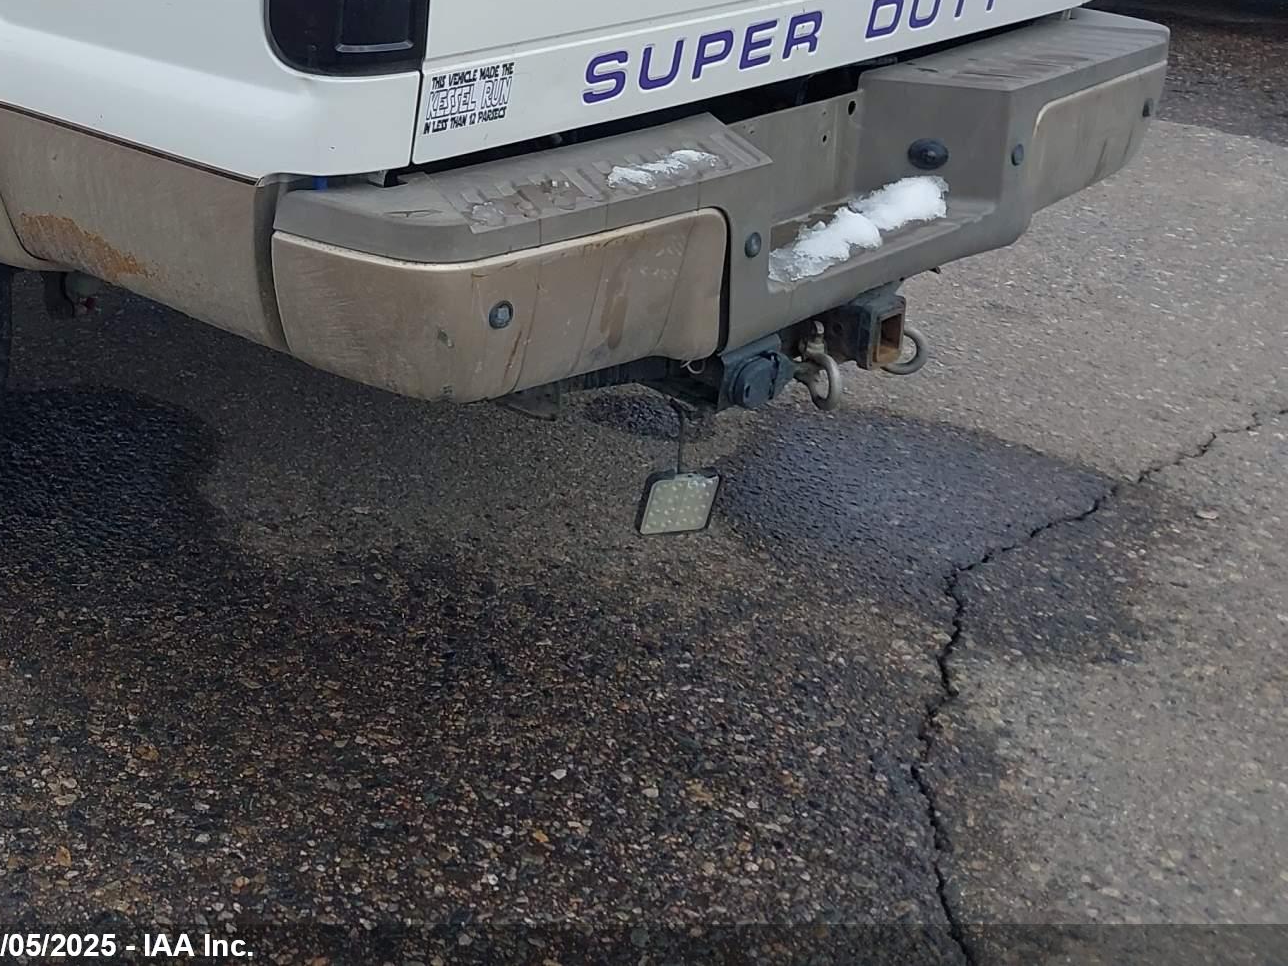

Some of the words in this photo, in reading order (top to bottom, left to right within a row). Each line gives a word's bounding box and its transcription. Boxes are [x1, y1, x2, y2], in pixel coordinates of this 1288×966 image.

[432, 75, 446, 88] THIS
[449, 69, 477, 86] VEHICLE
[479, 65, 500, 80] MADE
[502, 62, 514, 75] THE
[582, 10, 824, 105] SUPER
[426, 83, 476, 120] KESSEL
[480, 76, 512, 109] RUN
[423, 121, 431, 135] IN
[432, 118, 449, 133] LESS
[450, 114, 468, 129] THAN
[469, 112, 477, 125] 12
[477, 106, 507, 123] PARSECS
